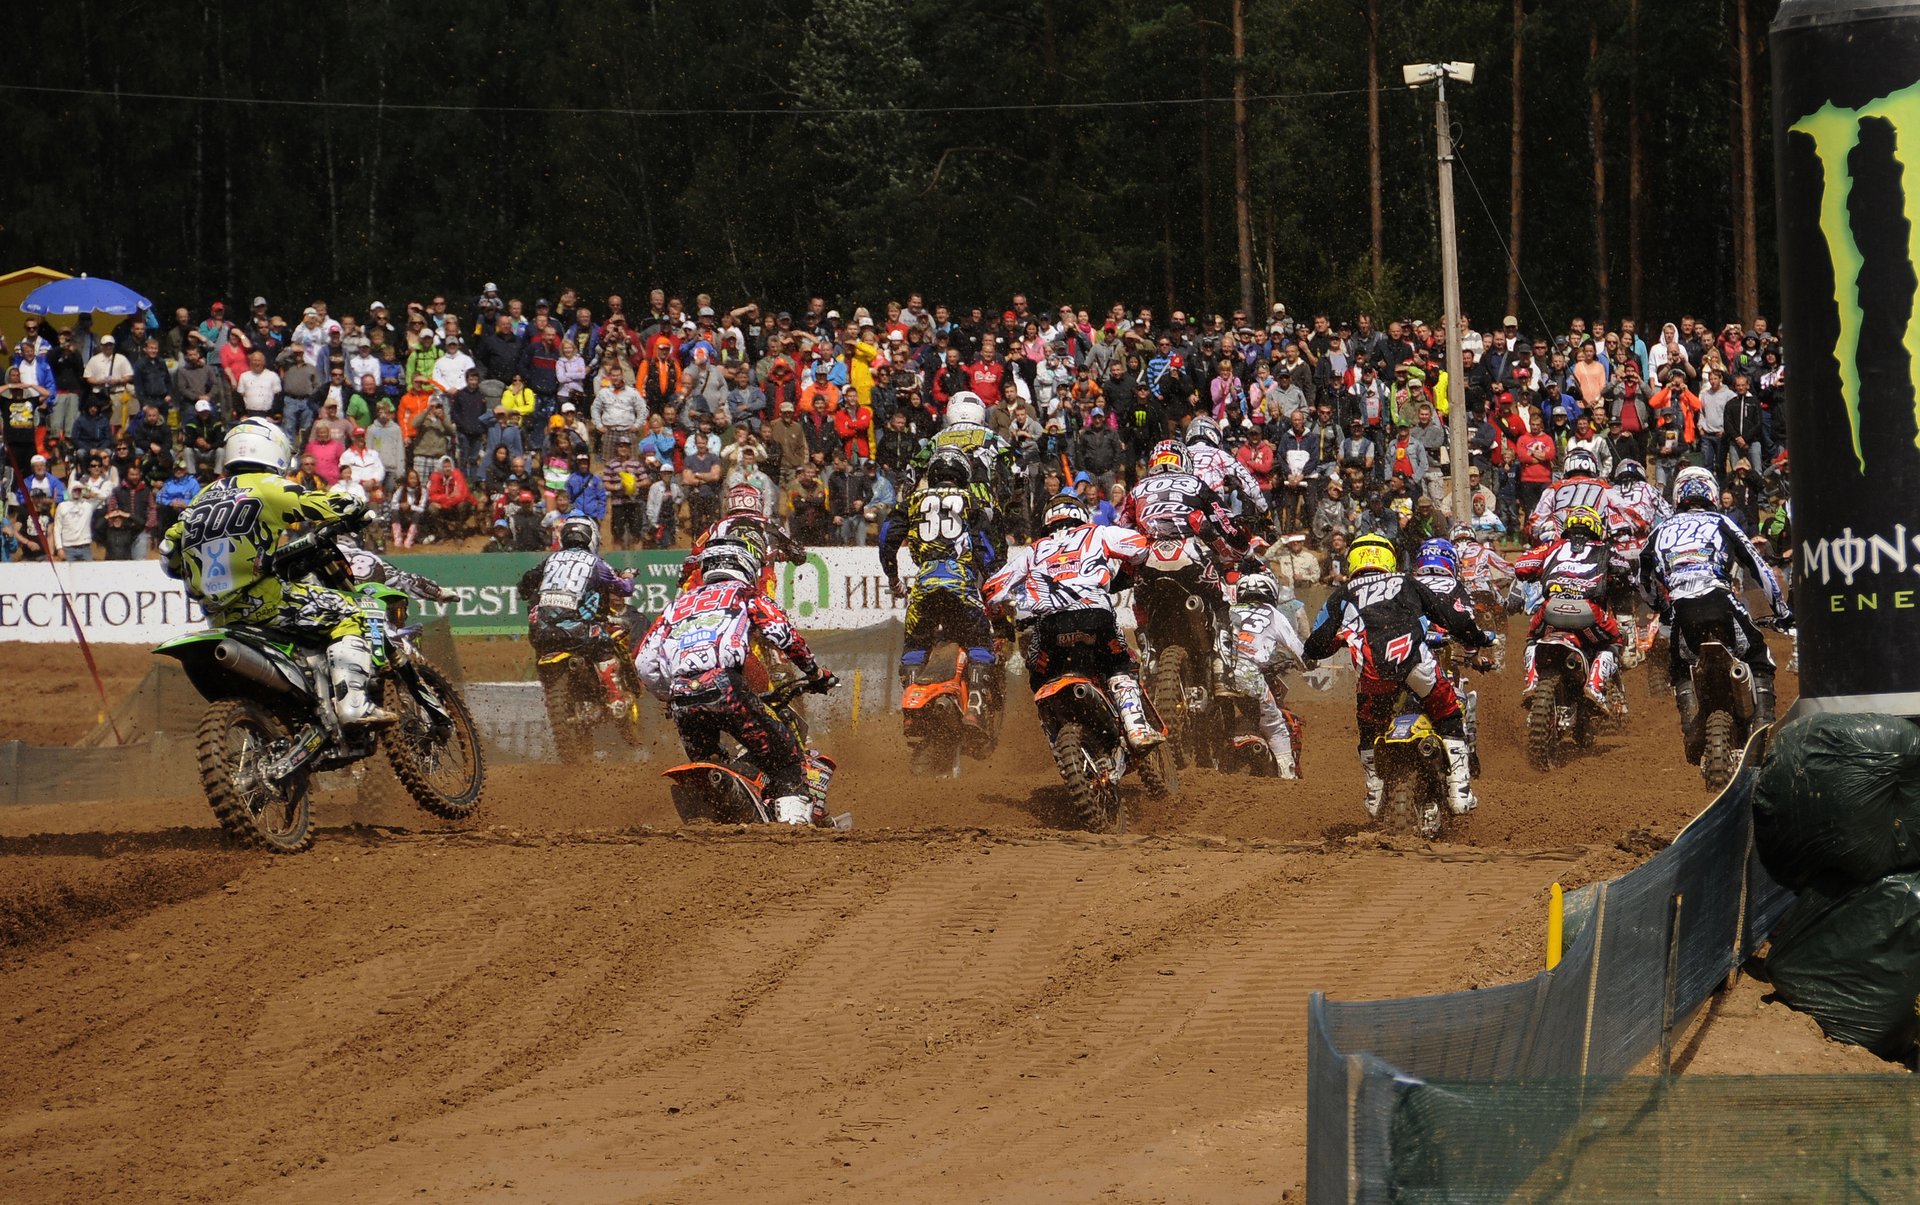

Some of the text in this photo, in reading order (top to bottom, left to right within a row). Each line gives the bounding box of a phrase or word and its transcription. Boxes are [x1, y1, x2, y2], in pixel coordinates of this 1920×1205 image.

[1132, 477, 1200, 499] 103
[1554, 484, 1603, 510] 911
[182, 498, 263, 553] 300
[919, 495, 963, 541] 33
[1659, 521, 1719, 550] 824
[1803, 523, 1920, 585] MON
[205, 582, 228, 592] Yota
[541, 560, 590, 593] 249
[672, 588, 737, 623] 221
[1356, 577, 1404, 609] 128
[1831, 590, 1915, 612] ENE
